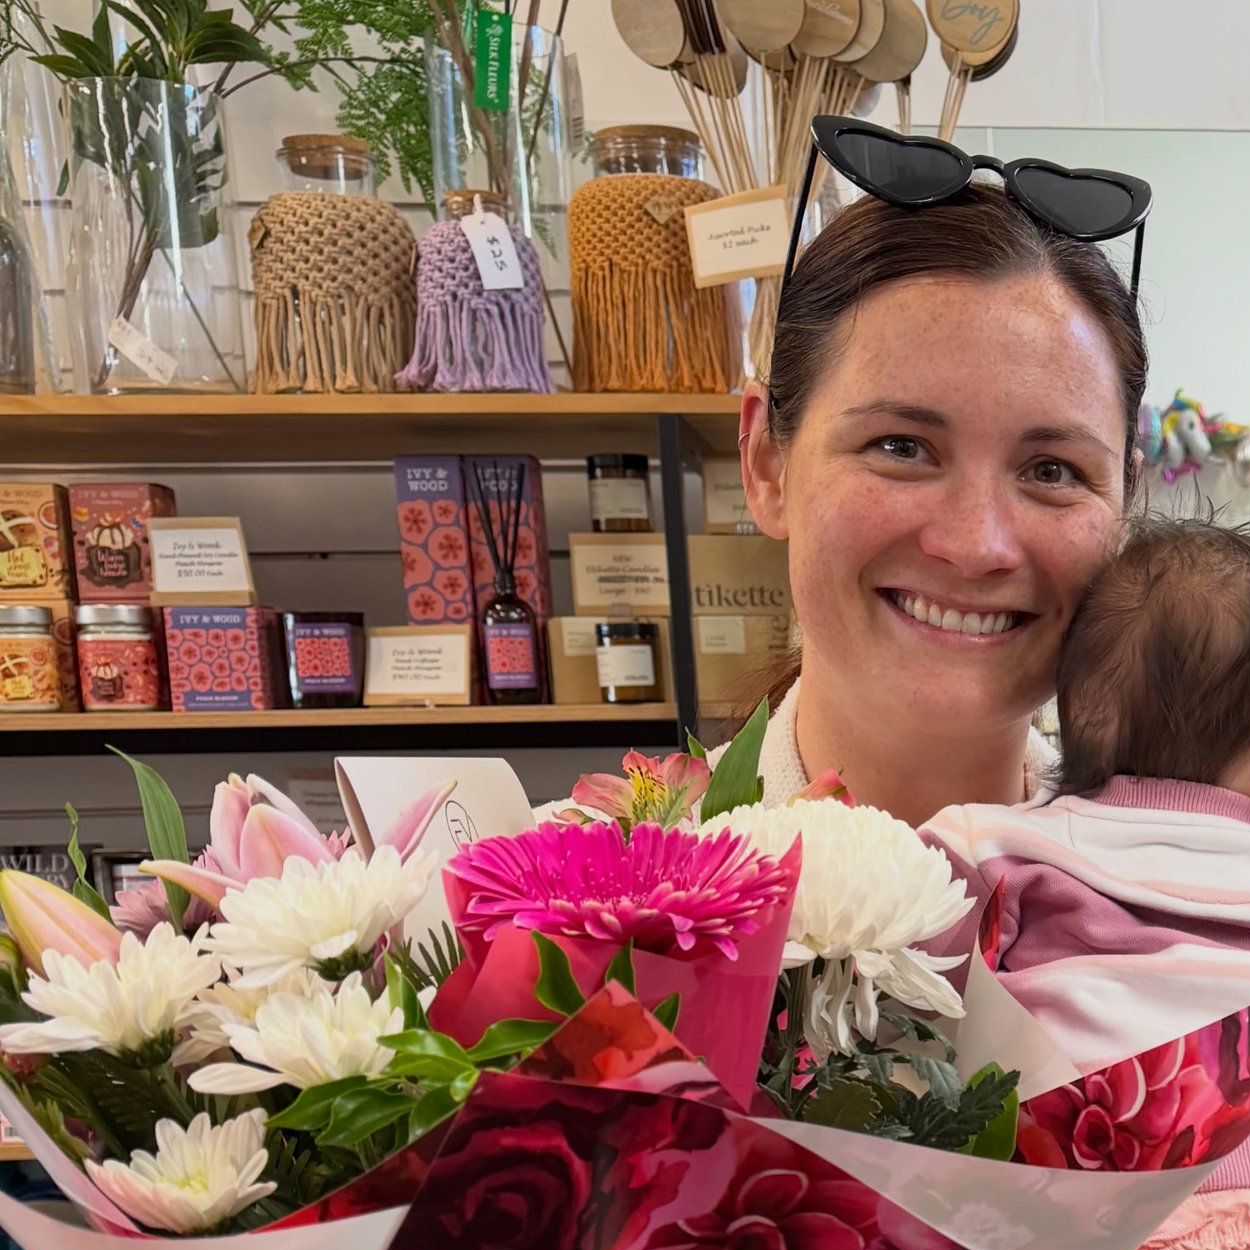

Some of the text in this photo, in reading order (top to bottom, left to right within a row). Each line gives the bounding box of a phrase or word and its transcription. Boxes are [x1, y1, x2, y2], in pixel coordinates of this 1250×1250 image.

[486, 36, 501, 99] SILK FLEURS
[405, 467, 449, 480] IVY &
[406, 480, 449, 492] WOOD
[693, 583, 786, 608] tikette
[179, 614, 242, 625] IVY & WOOD
[296, 628, 310, 637] IVY
[322, 628, 346, 637] WOOD
[0, 853, 70, 873] WILD
